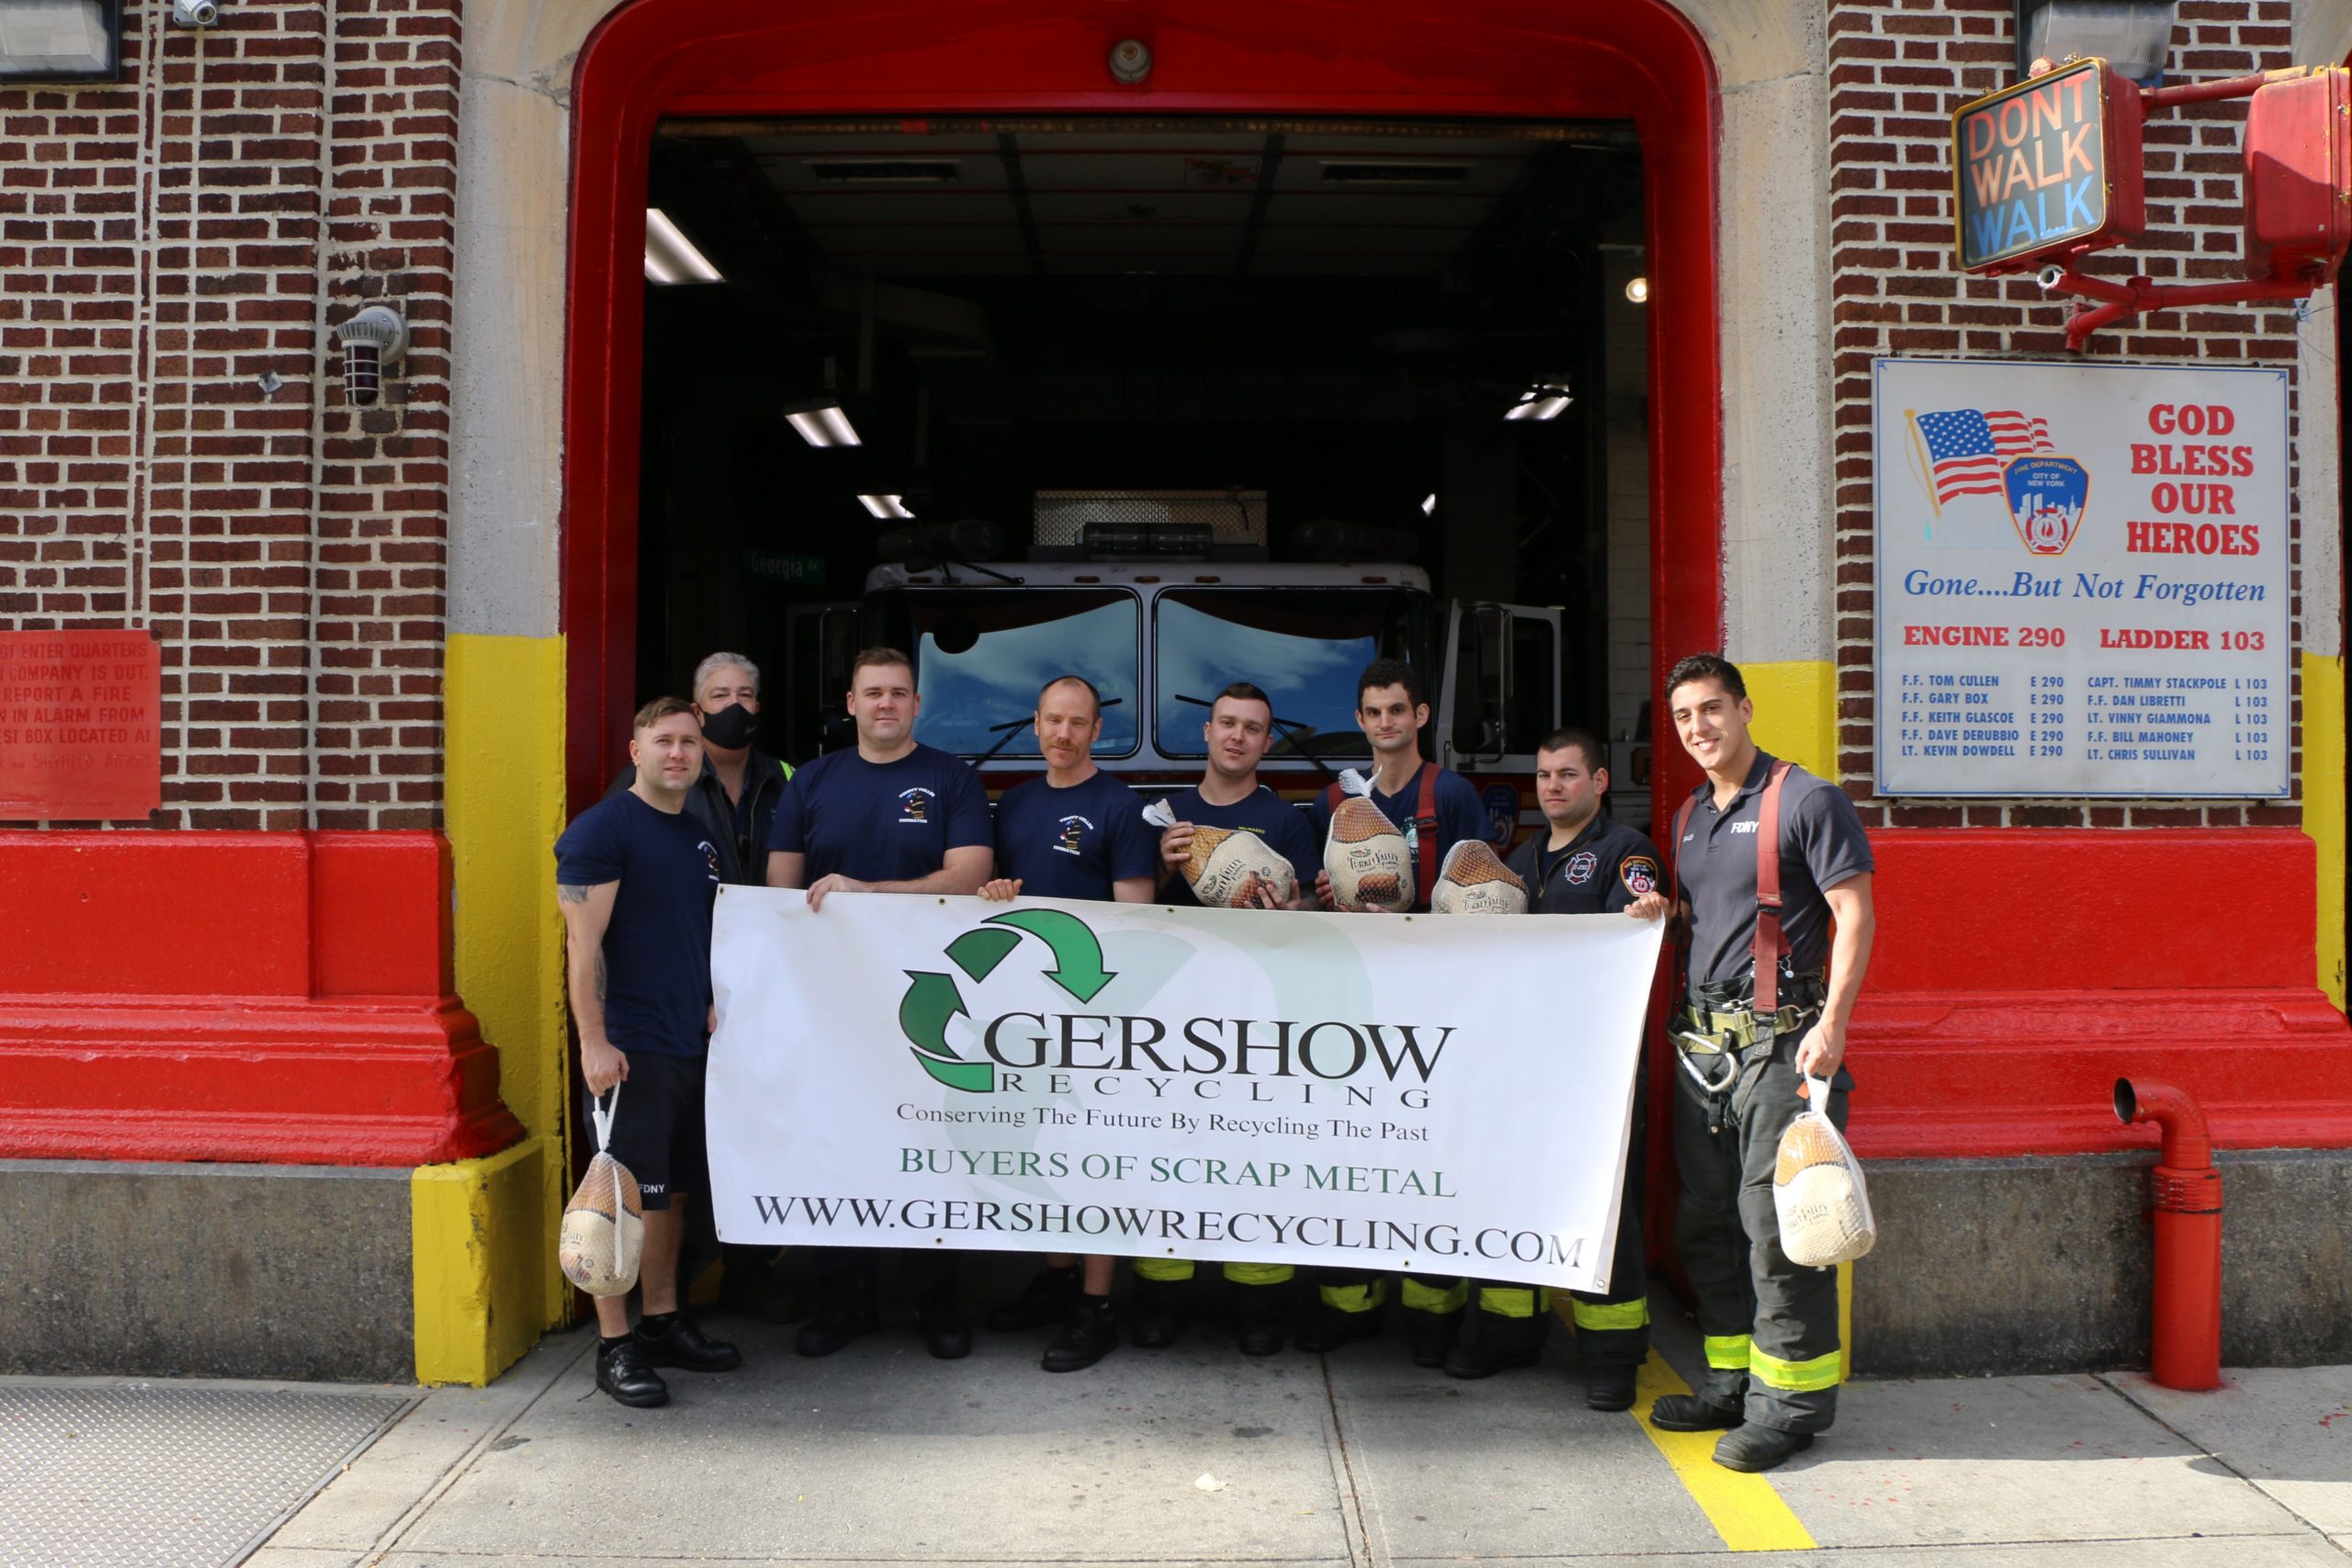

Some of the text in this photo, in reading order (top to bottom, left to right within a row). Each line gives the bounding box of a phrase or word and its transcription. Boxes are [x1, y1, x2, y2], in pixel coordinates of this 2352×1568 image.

[1967, 70, 2093, 161] DONT
[1971, 122, 2095, 208] WALK
[1973, 175, 2096, 257] WALK
[2149, 404, 2235, 435] GOD
[2030, 461, 2078, 475] DEPARTMENT
[2131, 444, 2254, 477] BLESS
[2152, 482, 2235, 514] OUR
[2127, 522, 2260, 556] HEROES
[752, 553, 803, 579] Georgia
[1905, 570, 2265, 605] Gone....But Not Forgotten
[1905, 626, 2065, 647] ENGINE 290
[2101, 629, 2265, 650] LADDER 103
[0, 643, 147, 660] OT ENTER QUARTERS
[10, 665, 83, 681] COMPANY
[92, 665, 107, 681] IS
[115, 665, 149, 681] OUT.
[1903, 675, 2064, 688] F.F. TOM CULLEN E 290
[2088, 677, 2267, 690] CAPT. TIMMY STACKPOLE L 103
[5, 687, 131, 702] REPORT A FIRE
[1903, 693, 2064, 705] F.F. GARY BOX E 290
[2088, 695, 2267, 708] F.F. DAN LIBRETTI L 103
[13, 708, 28, 723] IN
[34, 707, 90, 723] ALARM
[99, 707, 144, 723] FROM
[1903, 712, 2064, 725] F.F. KEITH GLASCOE E 290
[2088, 713, 2267, 725] LT. VINNY GIAMMONA L 103
[26, 729, 52, 744] BOX
[59, 728, 128, 743] LOCATED
[134, 728, 151, 742] AT
[1902, 729, 2064, 742] F.F. DAVE DERUBBIO E 290
[2088, 731, 2267, 743] F.F. BILL MAHONEY L 103
[1903, 746, 2064, 757] LT. KEVIN DOWDELL E 290
[2088, 750, 2268, 761] LT. CHRIS SULLIVAN L 103
[1730, 820, 1759, 834] FDNY
[984, 1011, 1458, 1084] GERSHOW
[1000, 1072, 1432, 1111] RECYCLING
[898, 1104, 1427, 1141] Conserving The Future By Recycling The Past
[901, 1148, 1455, 1197] BUYERS OF SCRAP METAL
[752, 1194, 1586, 1268] WWW.GERSHOWRECYCLING.COM
